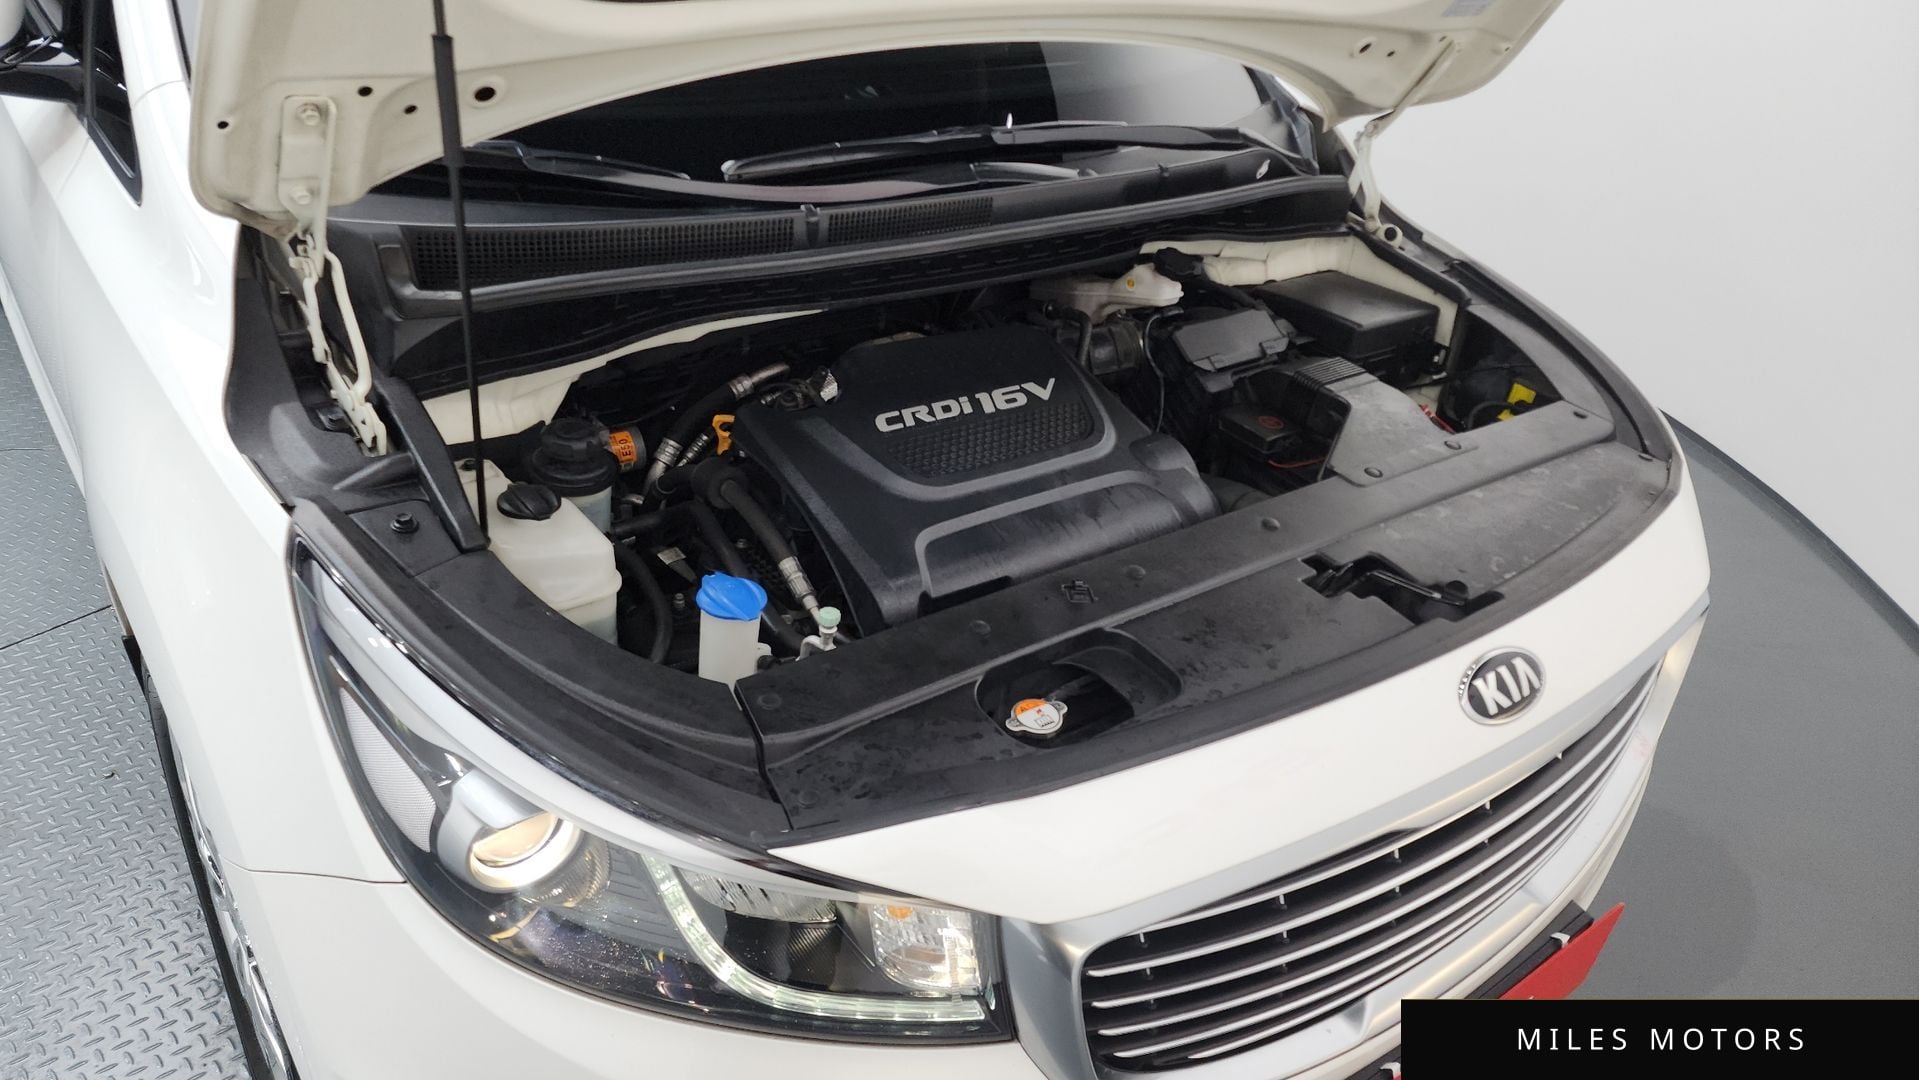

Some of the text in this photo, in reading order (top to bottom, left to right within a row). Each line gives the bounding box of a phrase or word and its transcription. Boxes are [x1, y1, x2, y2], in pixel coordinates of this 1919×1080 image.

[875, 378, 1055, 432] CRDi 16V
[1471, 656, 1541, 716] KIA
